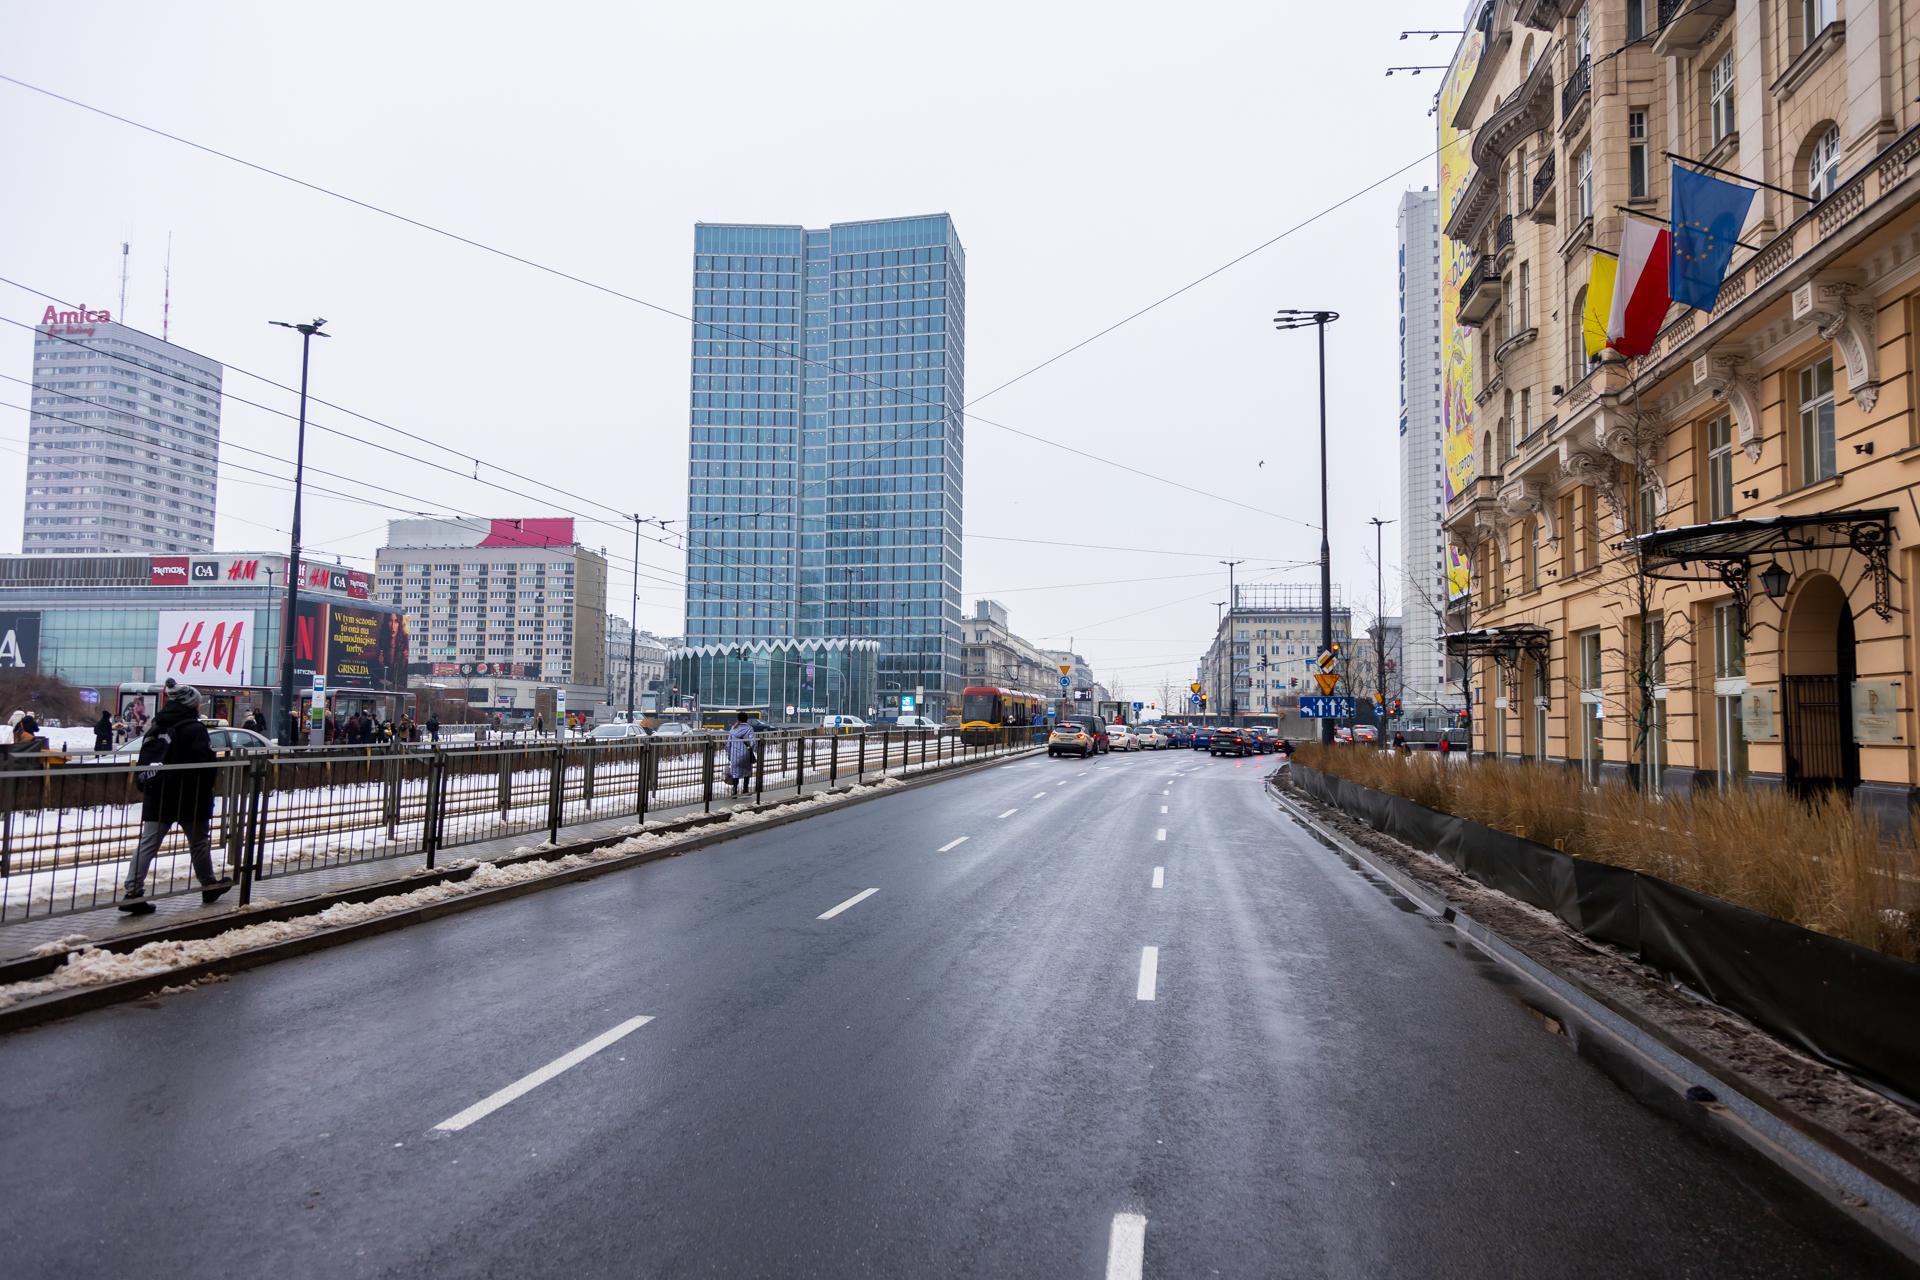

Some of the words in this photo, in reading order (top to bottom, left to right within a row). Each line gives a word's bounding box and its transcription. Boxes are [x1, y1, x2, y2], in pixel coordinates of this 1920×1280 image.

[41, 304, 111, 325] Amica
[194, 565, 214, 577] C&A
[227, 559, 258, 580] H&M
[334, 612, 342, 622] W
[342, 614, 354, 625] tym
[340, 623, 348, 632] to
[348, 626, 359, 634] ona
[167, 621, 244, 675] H&M
[337, 664, 369, 675] GRISELDA
